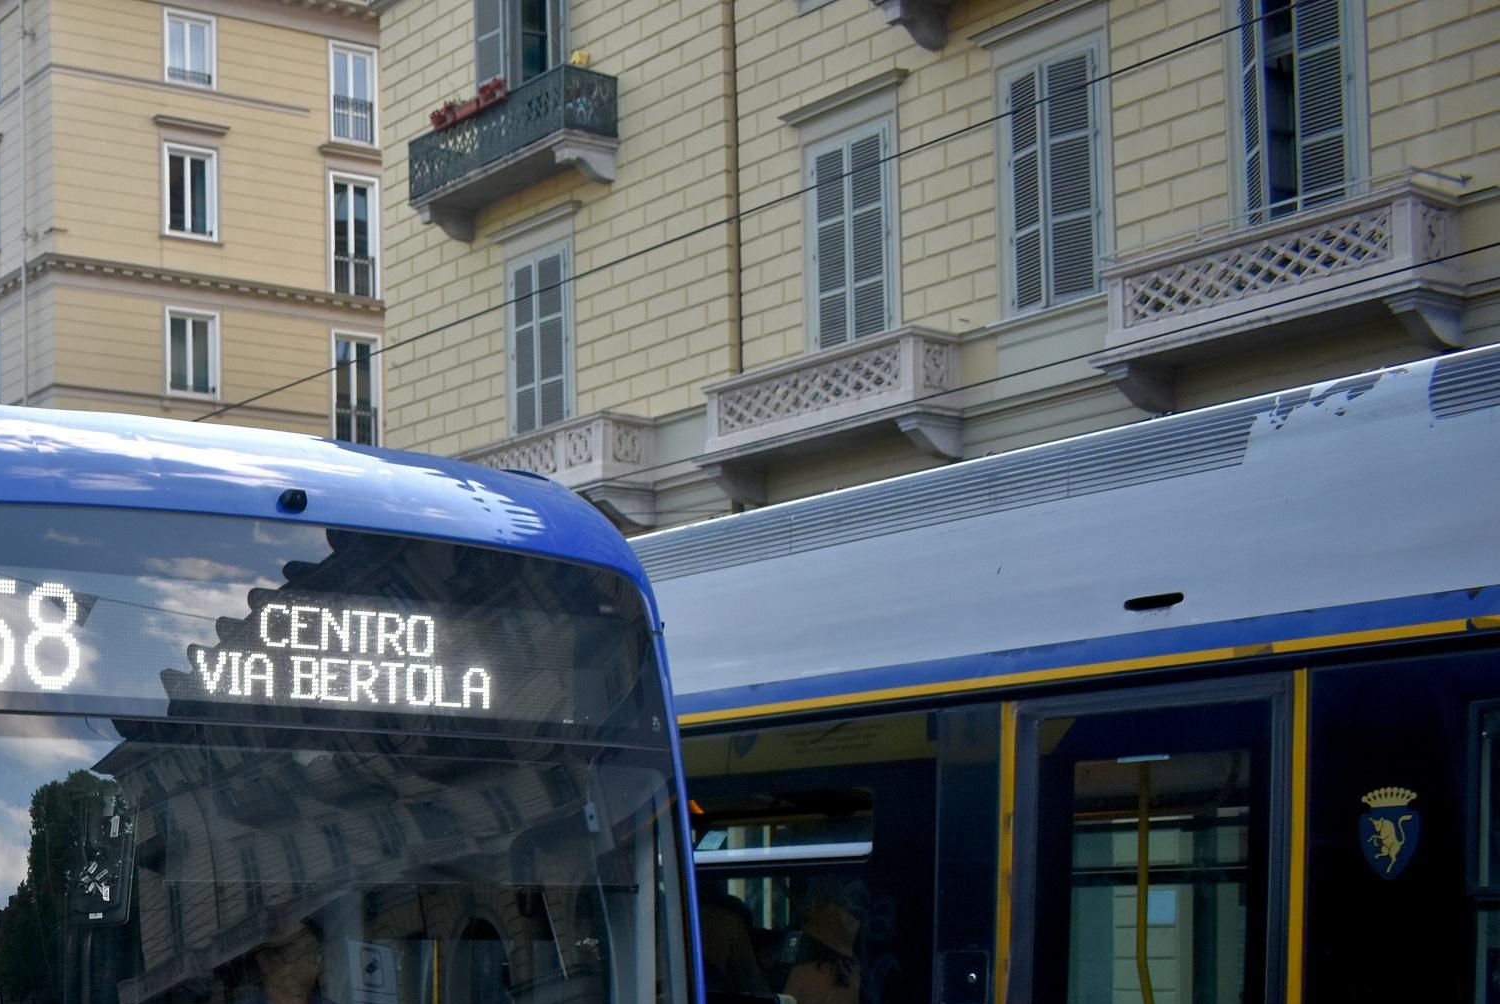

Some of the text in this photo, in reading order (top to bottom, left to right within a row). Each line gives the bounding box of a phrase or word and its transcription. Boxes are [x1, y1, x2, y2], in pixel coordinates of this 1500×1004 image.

[258, 602, 436, 659] CENTRO
[195, 647, 493, 711] VIA BERTOLA
